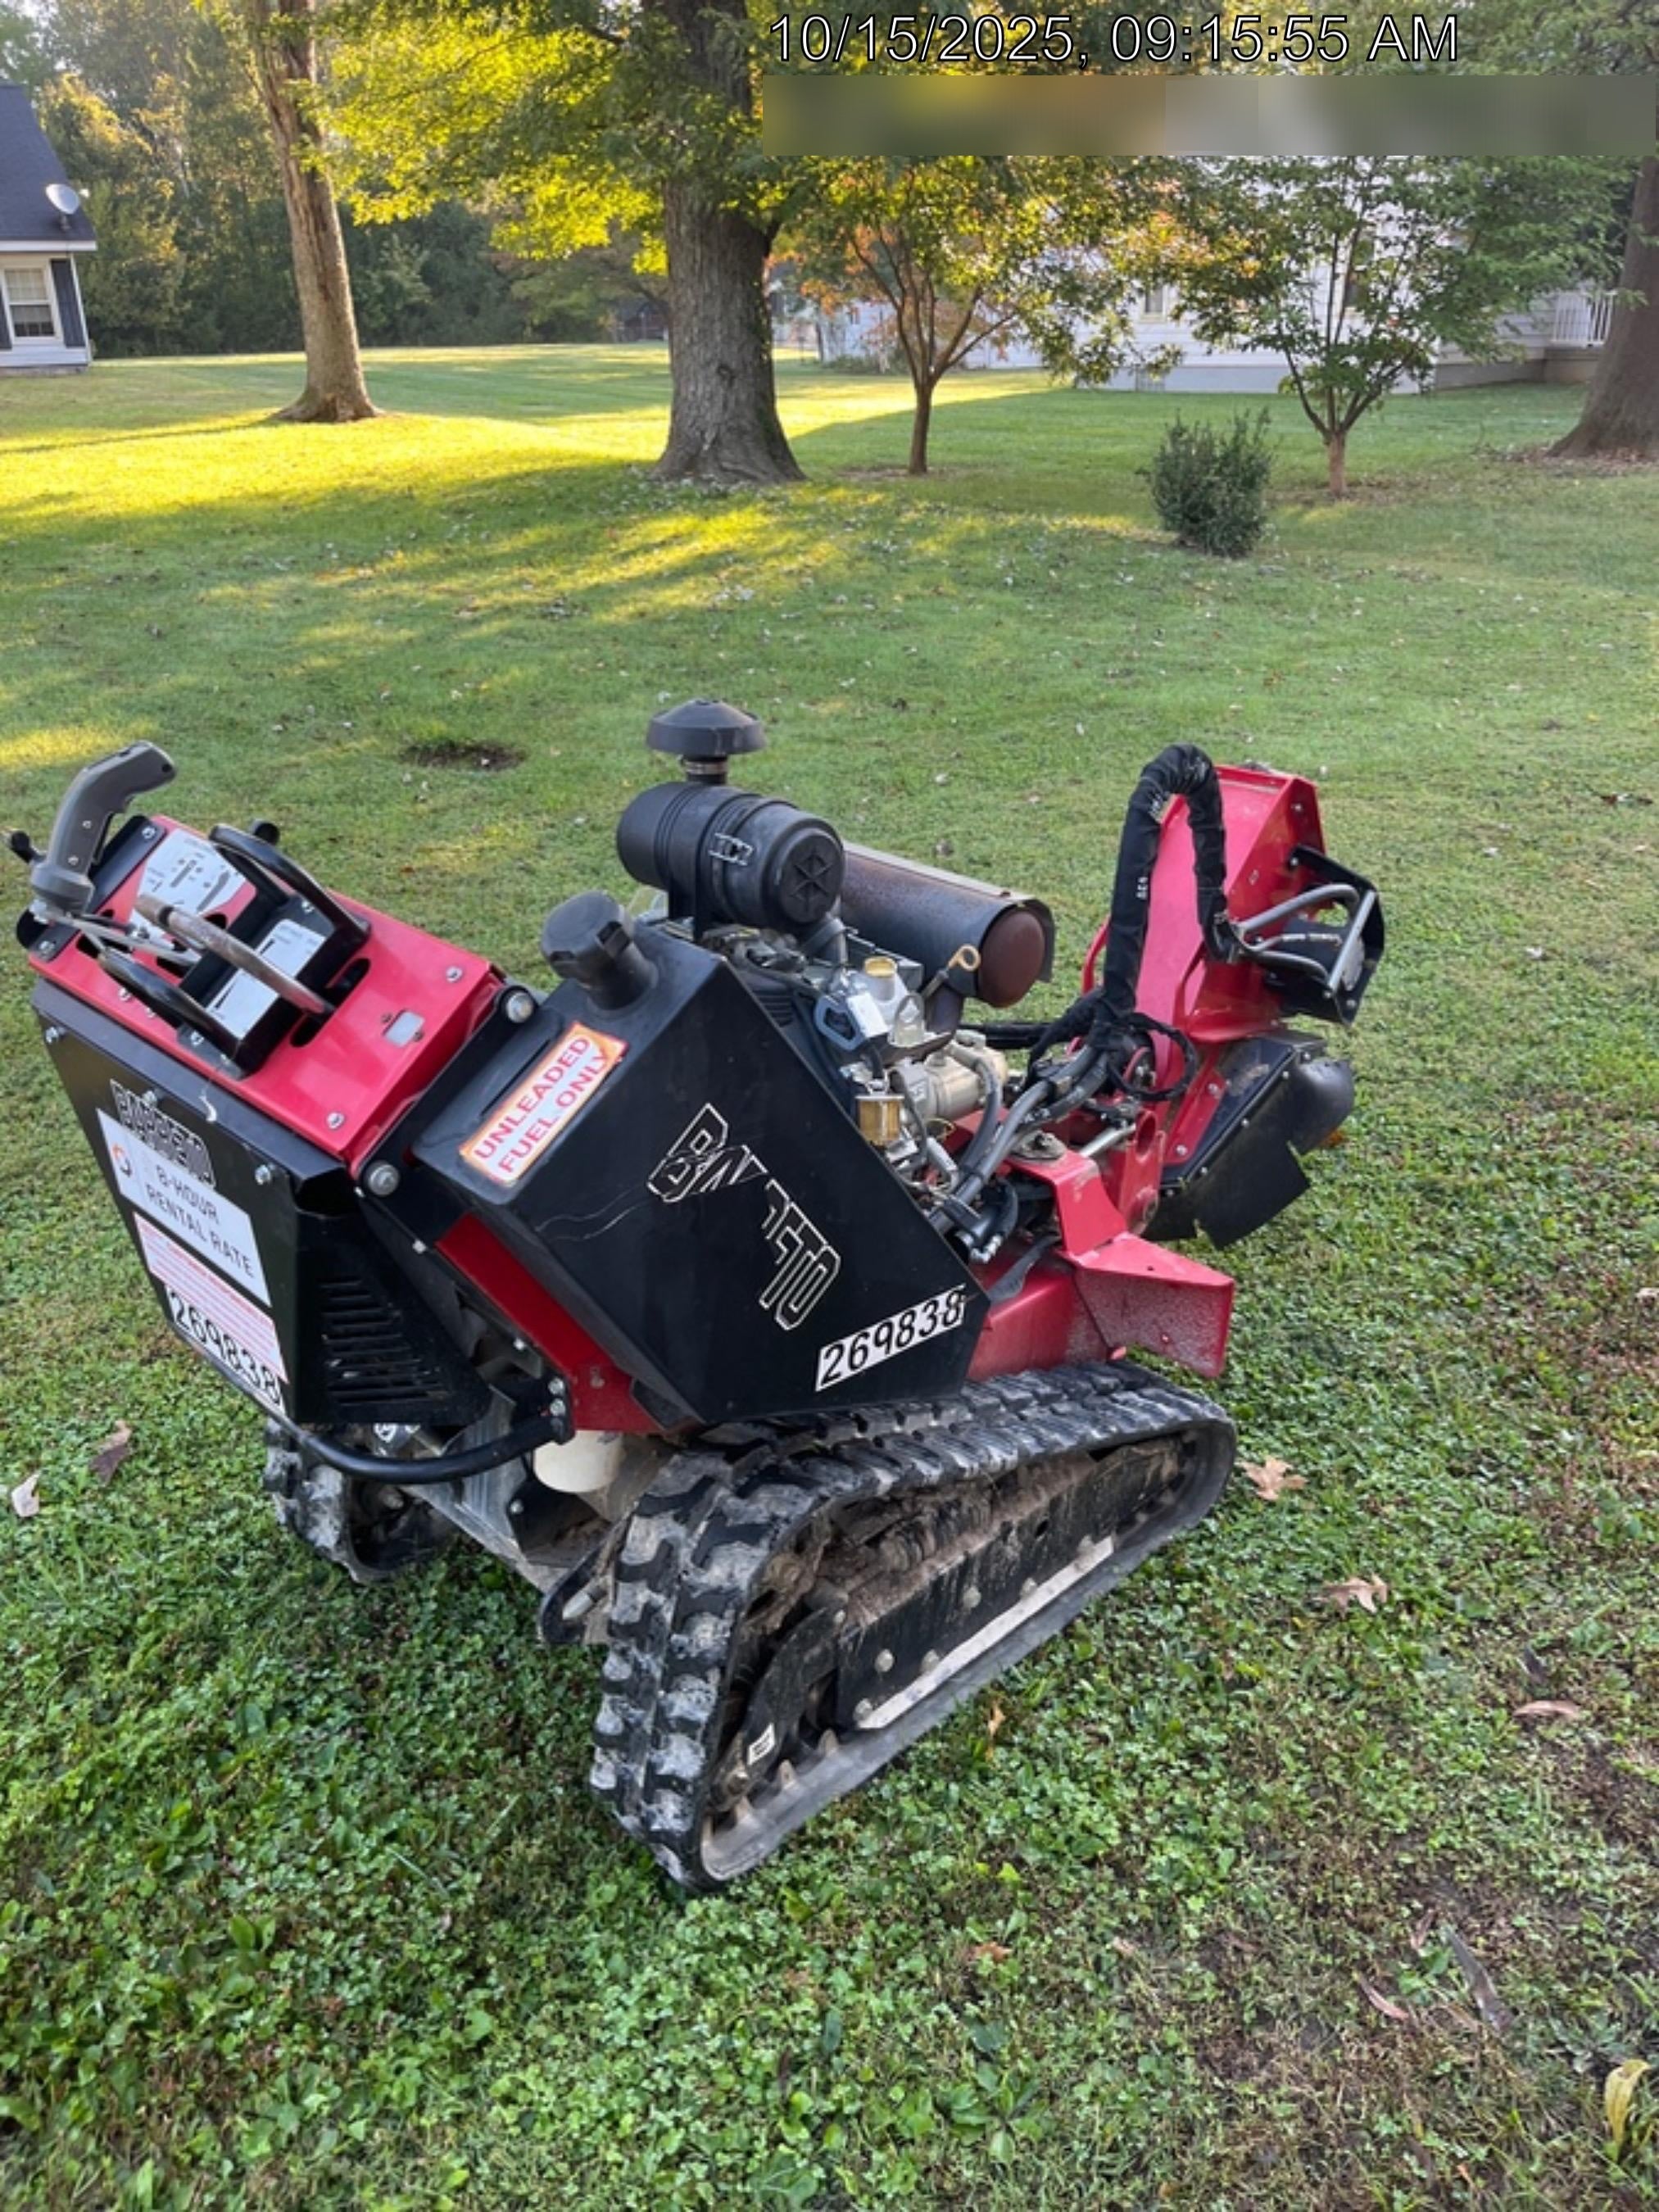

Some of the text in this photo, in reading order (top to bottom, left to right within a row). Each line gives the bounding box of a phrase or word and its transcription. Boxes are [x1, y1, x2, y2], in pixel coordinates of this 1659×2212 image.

[474, 1036, 591, 1159] UNLEADED
[498, 1051, 608, 1173] FUEL ONLY
[145, 1182, 256, 1277] RENTAL RATE
[156, 1163, 220, 1226] 8-HOUR
[169, 1290, 282, 1405] 269838
[820, 1290, 965, 1387] 269838
